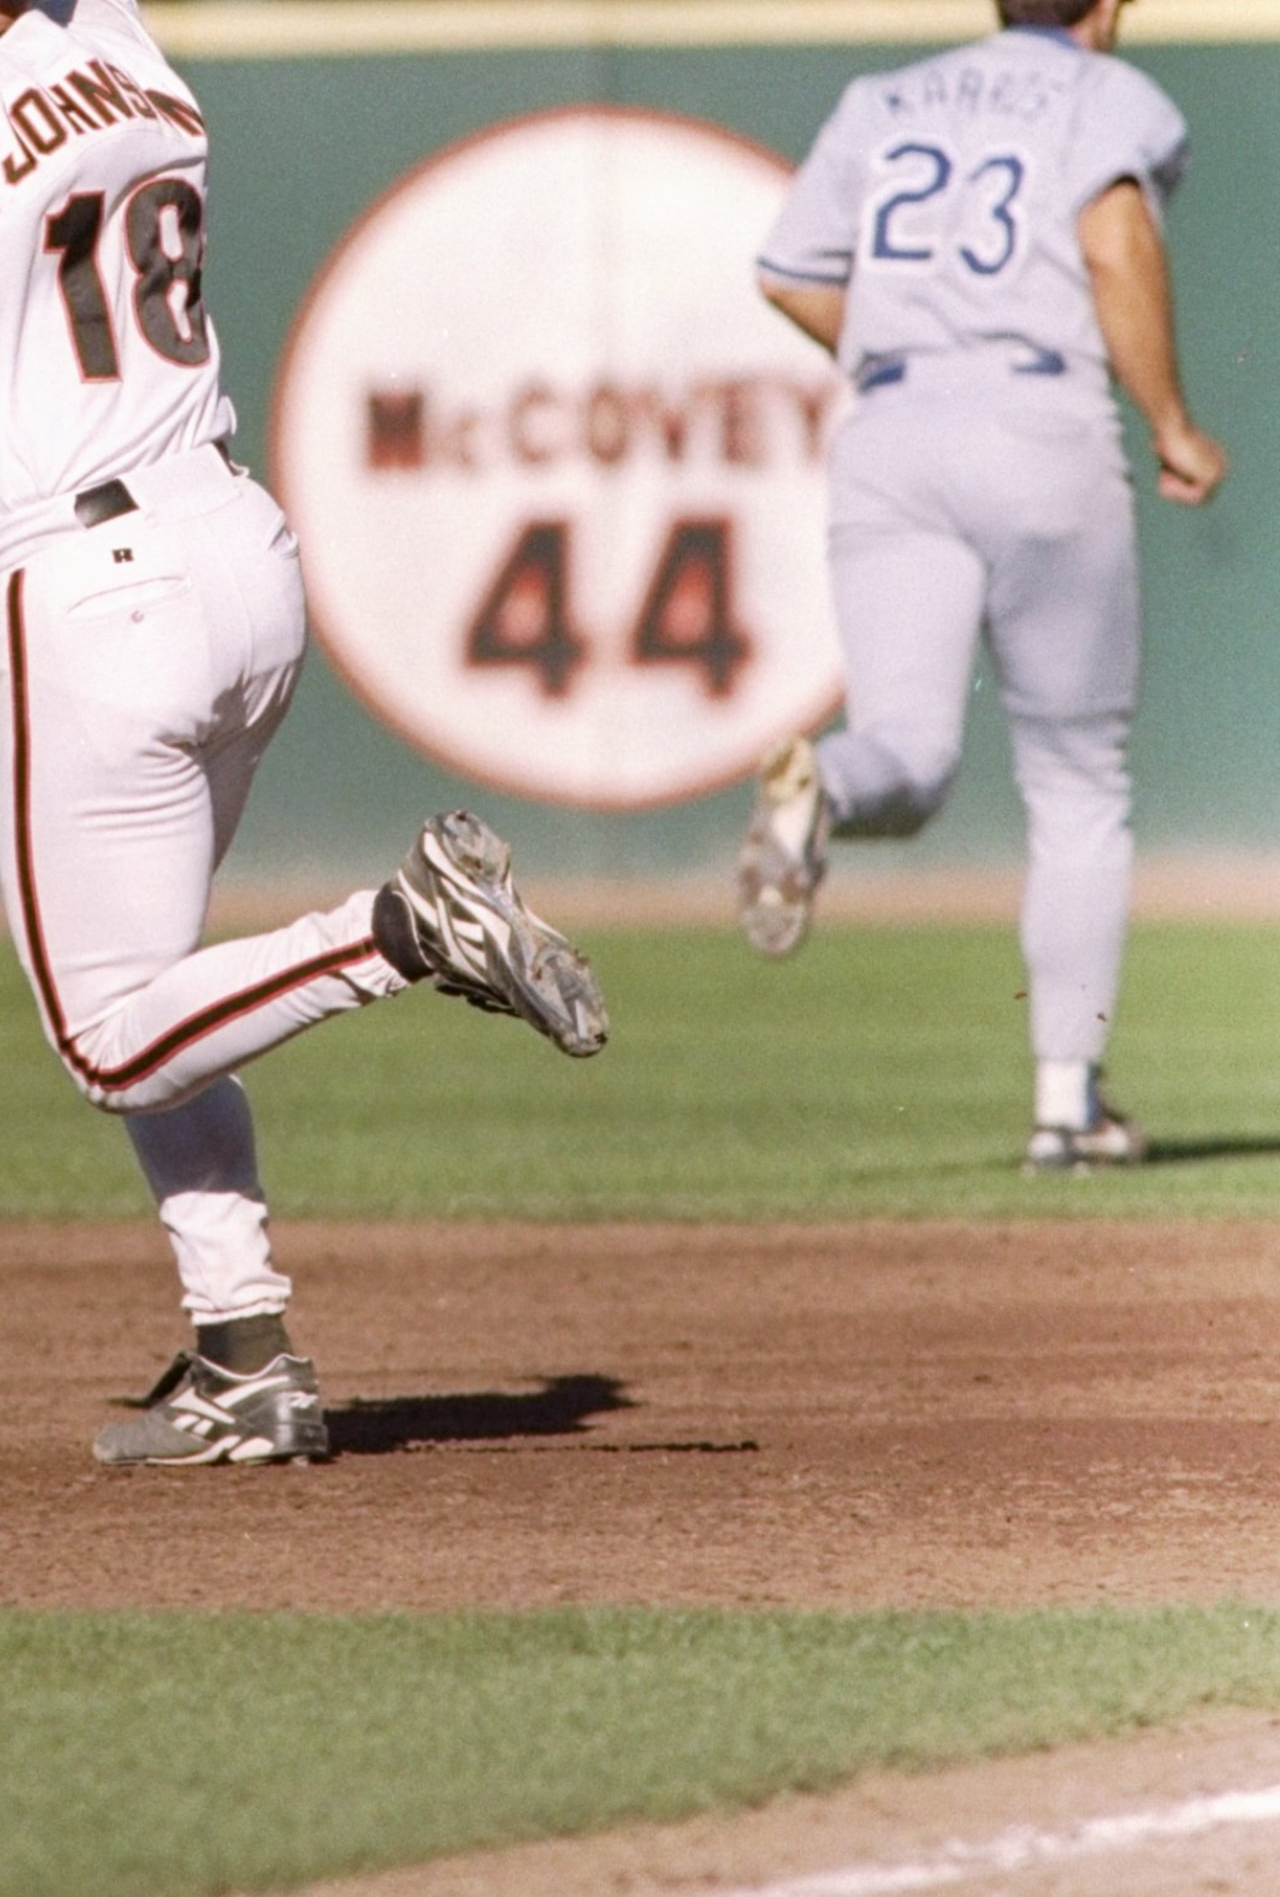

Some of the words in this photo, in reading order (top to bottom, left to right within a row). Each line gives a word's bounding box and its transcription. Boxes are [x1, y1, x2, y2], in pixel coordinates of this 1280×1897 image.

[43, 176, 210, 383] 18
[872, 141, 1024, 274] 23
[463, 519, 751, 700] 44
